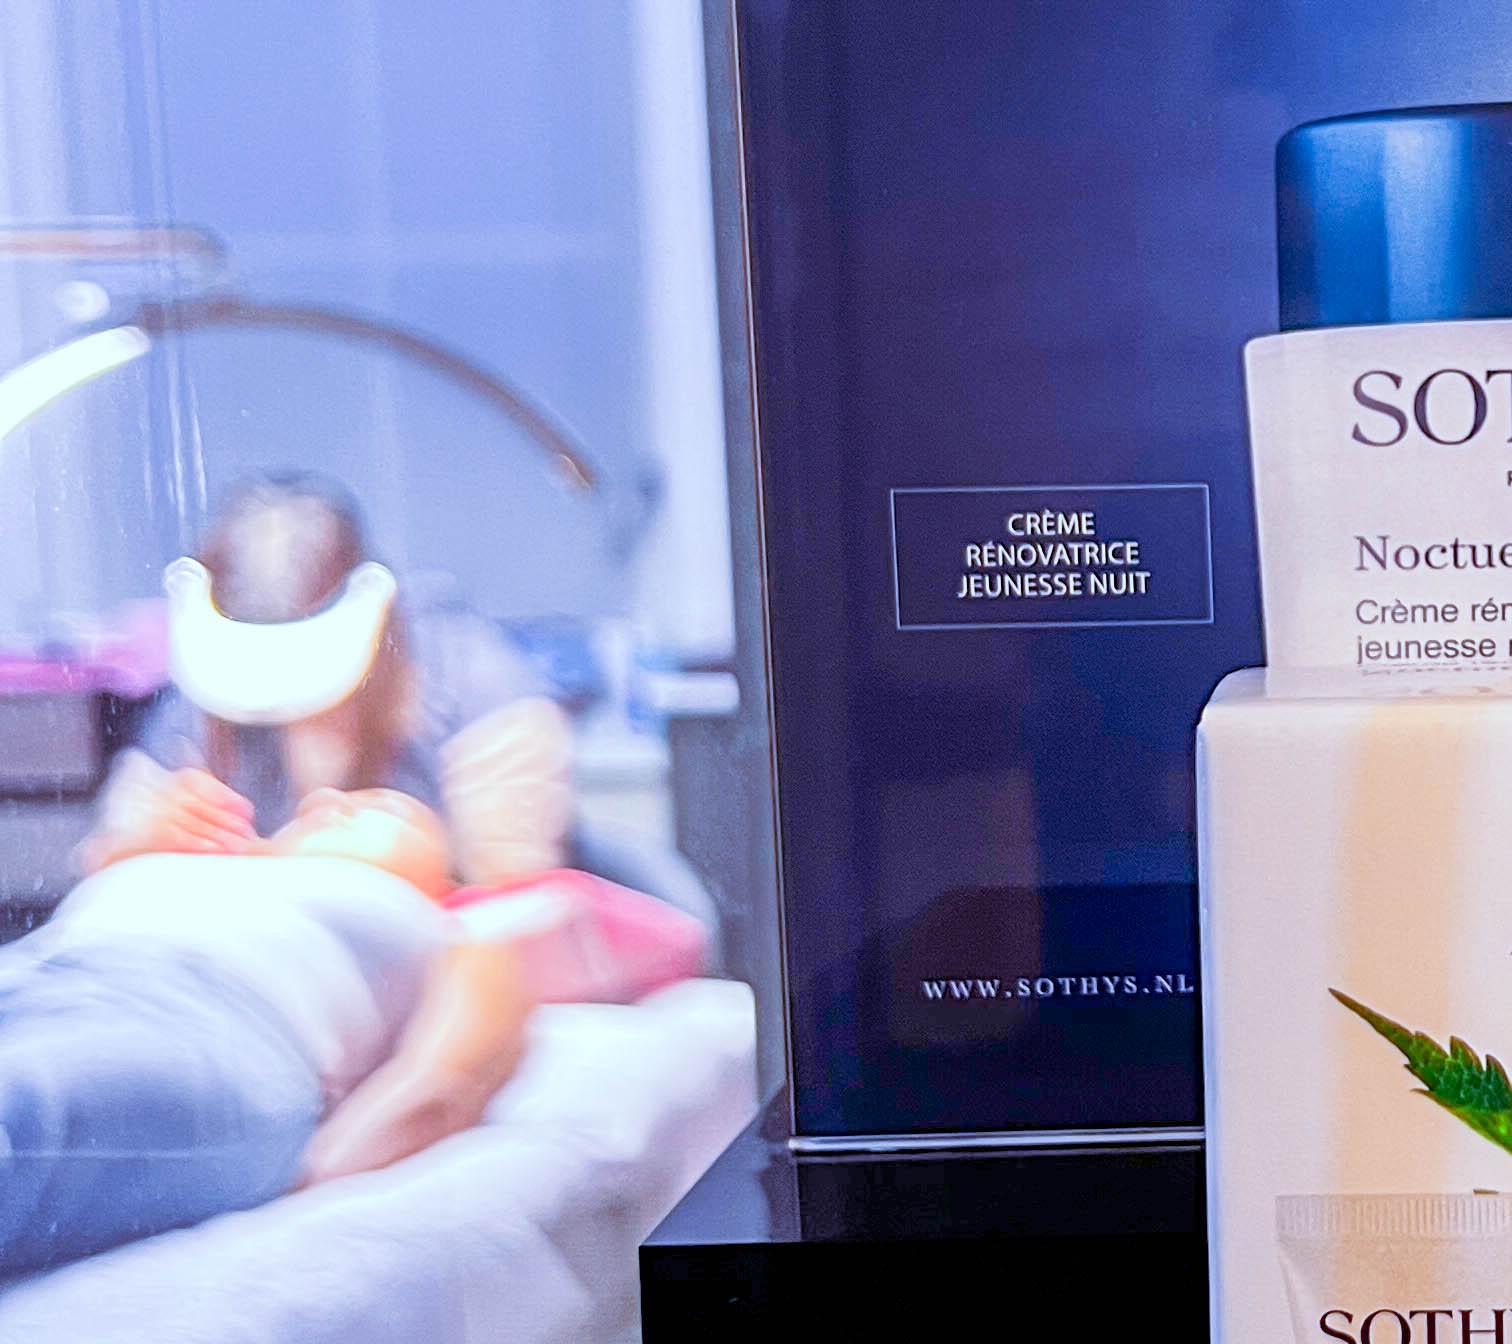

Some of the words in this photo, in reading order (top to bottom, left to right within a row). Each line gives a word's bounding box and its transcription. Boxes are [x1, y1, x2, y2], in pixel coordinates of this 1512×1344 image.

[1007, 509, 1095, 536] CRÈME
[966, 541, 1140, 567] RÉNOVATRICE
[957, 573, 1083, 599] JEUNESSE
[1090, 571, 1151, 595] NUIT
[1355, 599, 1459, 626] Crème
[1357, 633, 1497, 664] jeunesse
[922, 974, 1194, 1001] WWW.SOTHYS.NL
